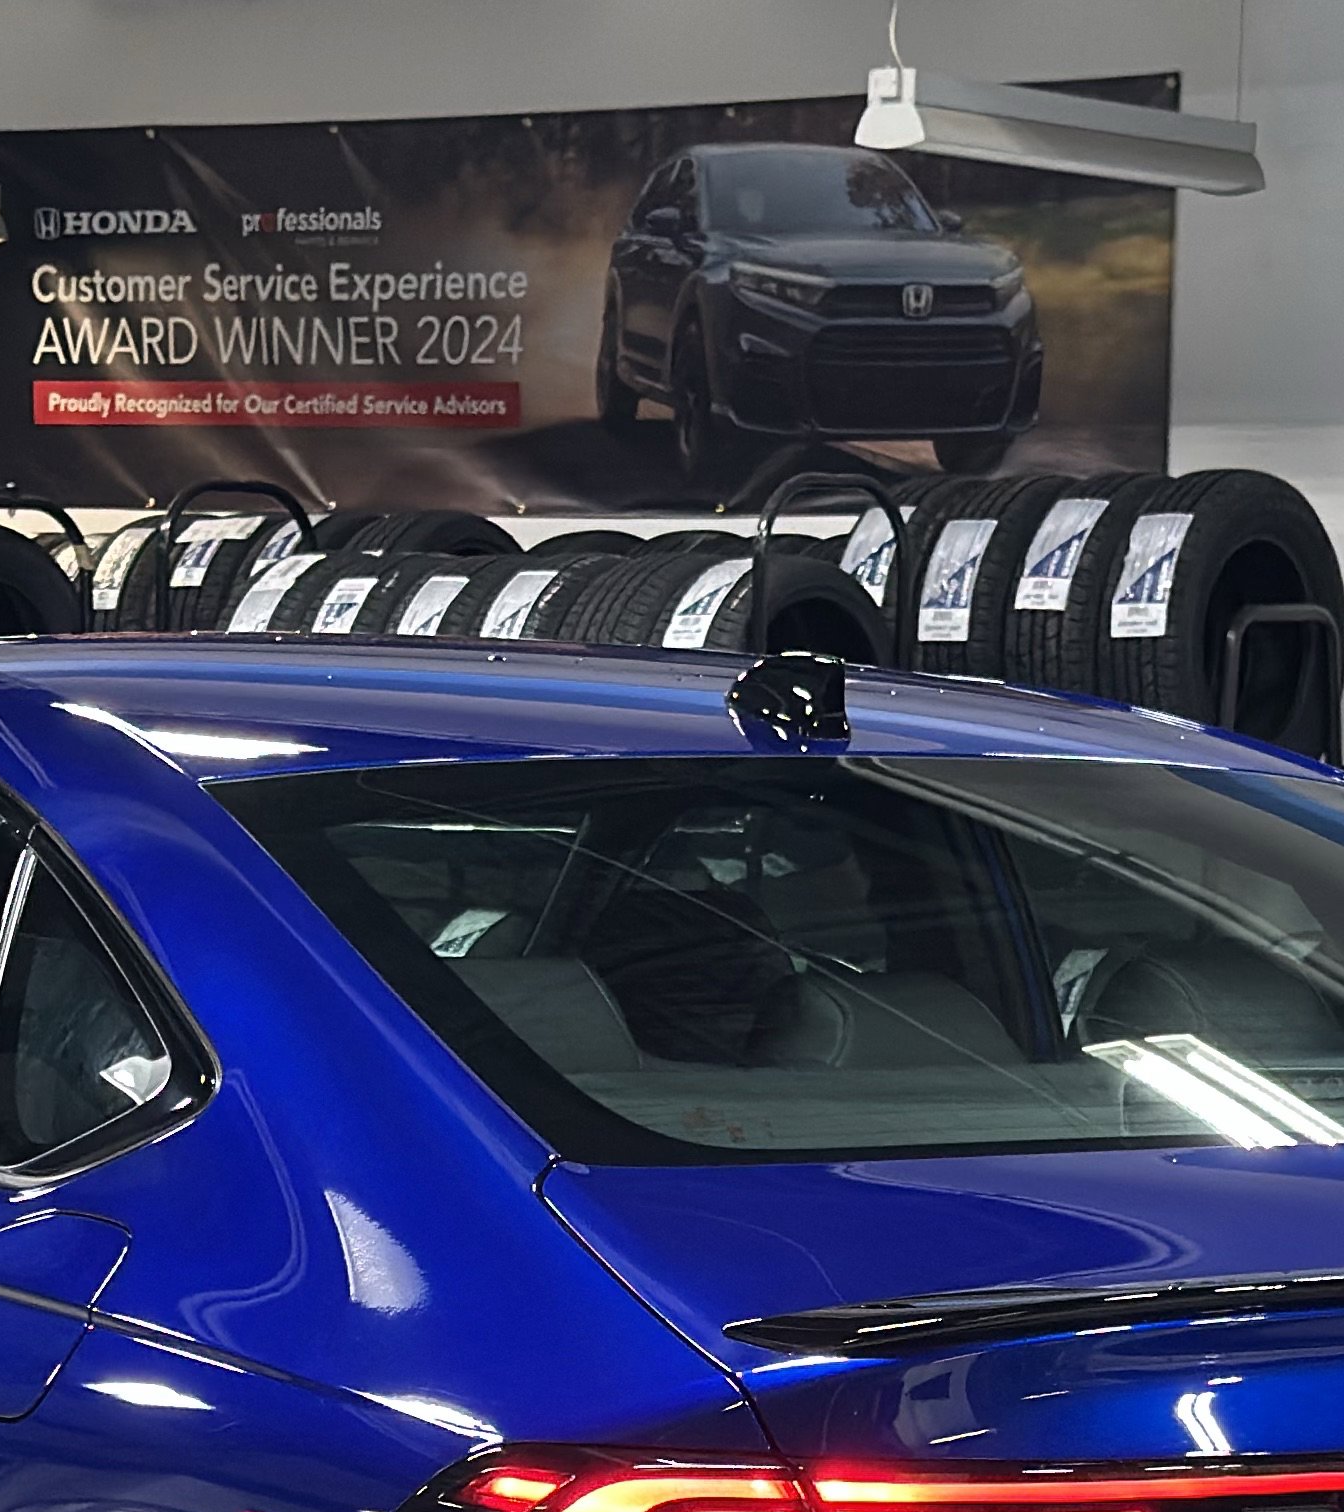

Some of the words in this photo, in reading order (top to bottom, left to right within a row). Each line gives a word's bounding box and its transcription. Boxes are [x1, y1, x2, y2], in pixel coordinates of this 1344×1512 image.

[63, 209, 198, 235] HONDA
[241, 206, 383, 237] professionals
[32, 264, 192, 303] Customer
[203, 262, 318, 302] Service
[329, 260, 528, 312] Experience
[32, 316, 198, 365] AWARD
[214, 316, 402, 365] WINNER
[415, 313, 523, 365] 2024
[48, 392, 110, 418] Proudly
[114, 392, 213, 418] Recognized
[216, 393, 238, 412] for
[244, 394, 279, 413] Our
[284, 393, 358, 414] Certified
[362, 395, 428, 415] Service
[433, 394, 507, 415] Advisors
